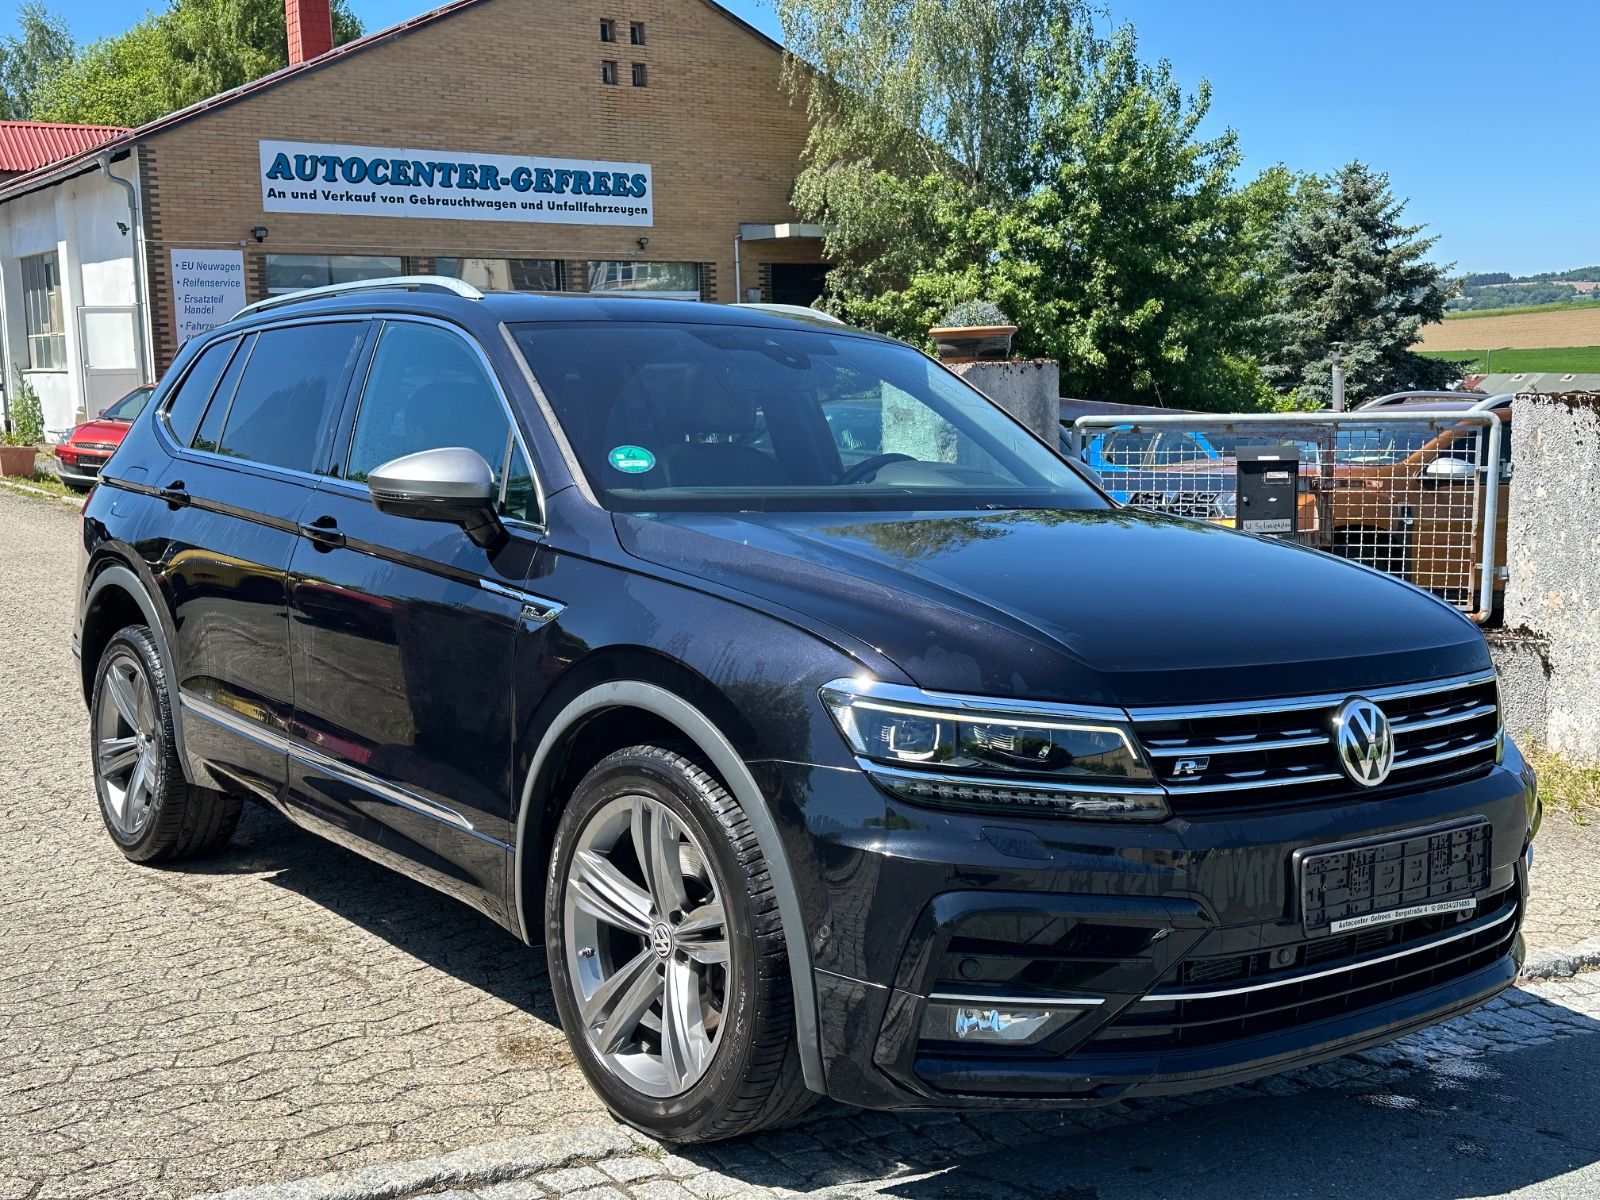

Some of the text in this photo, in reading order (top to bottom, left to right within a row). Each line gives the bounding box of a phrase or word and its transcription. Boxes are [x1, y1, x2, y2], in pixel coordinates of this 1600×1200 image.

[266, 152, 647, 198] AUTOCENTER-GEFREES
[267, 188, 648, 216] An und Verkauf von Gebrauchtwagen und Unfallfahrzeugen
[181, 261, 241, 272] EU Neuwagen
[182, 277, 241, 287] Reifenservice
[184, 294, 224, 304] Ersatzteil
[184, 305, 214, 314] Handel
[625, 449, 636, 459] 4
